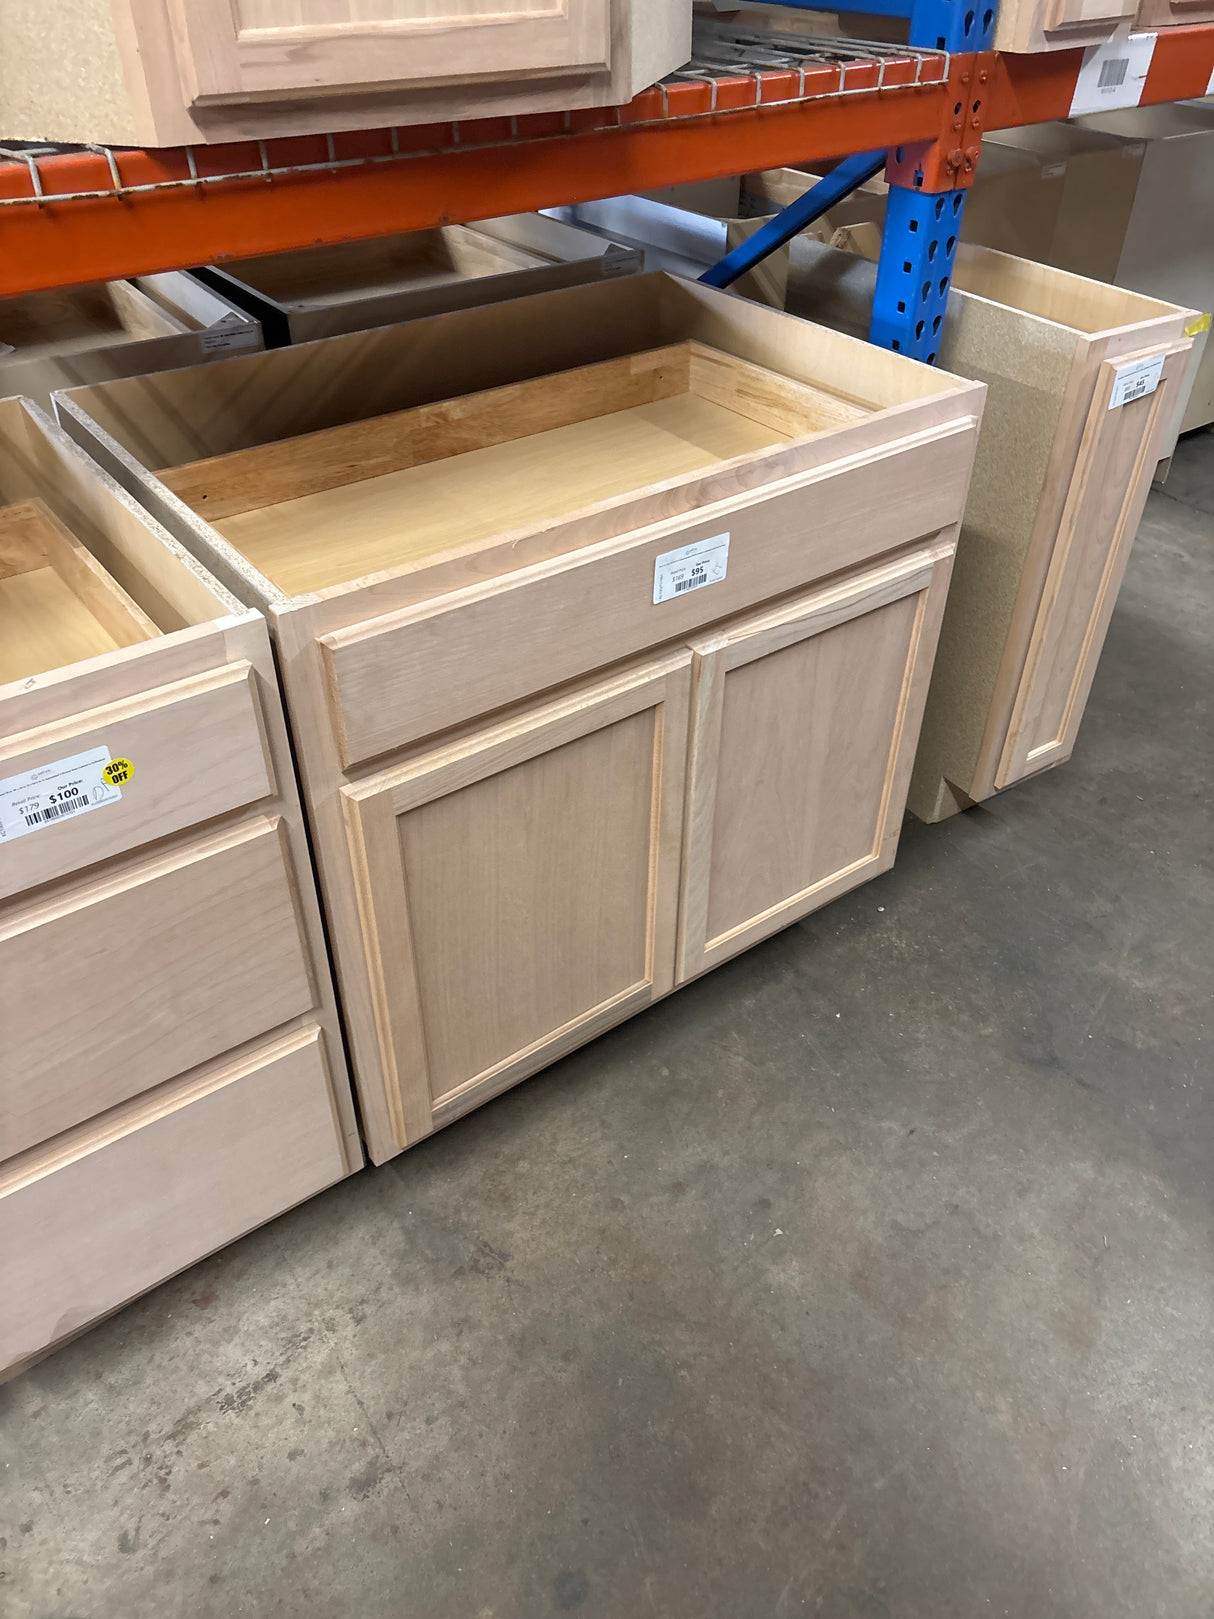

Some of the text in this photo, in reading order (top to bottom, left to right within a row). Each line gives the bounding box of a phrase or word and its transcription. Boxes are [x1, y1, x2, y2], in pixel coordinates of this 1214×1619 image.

[691, 566, 704, 577] $95
[105, 760, 128, 776] 30%
[111, 770, 128, 784] OFF
[49, 787, 79, 805] $100
[19, 801, 40, 815] $179
